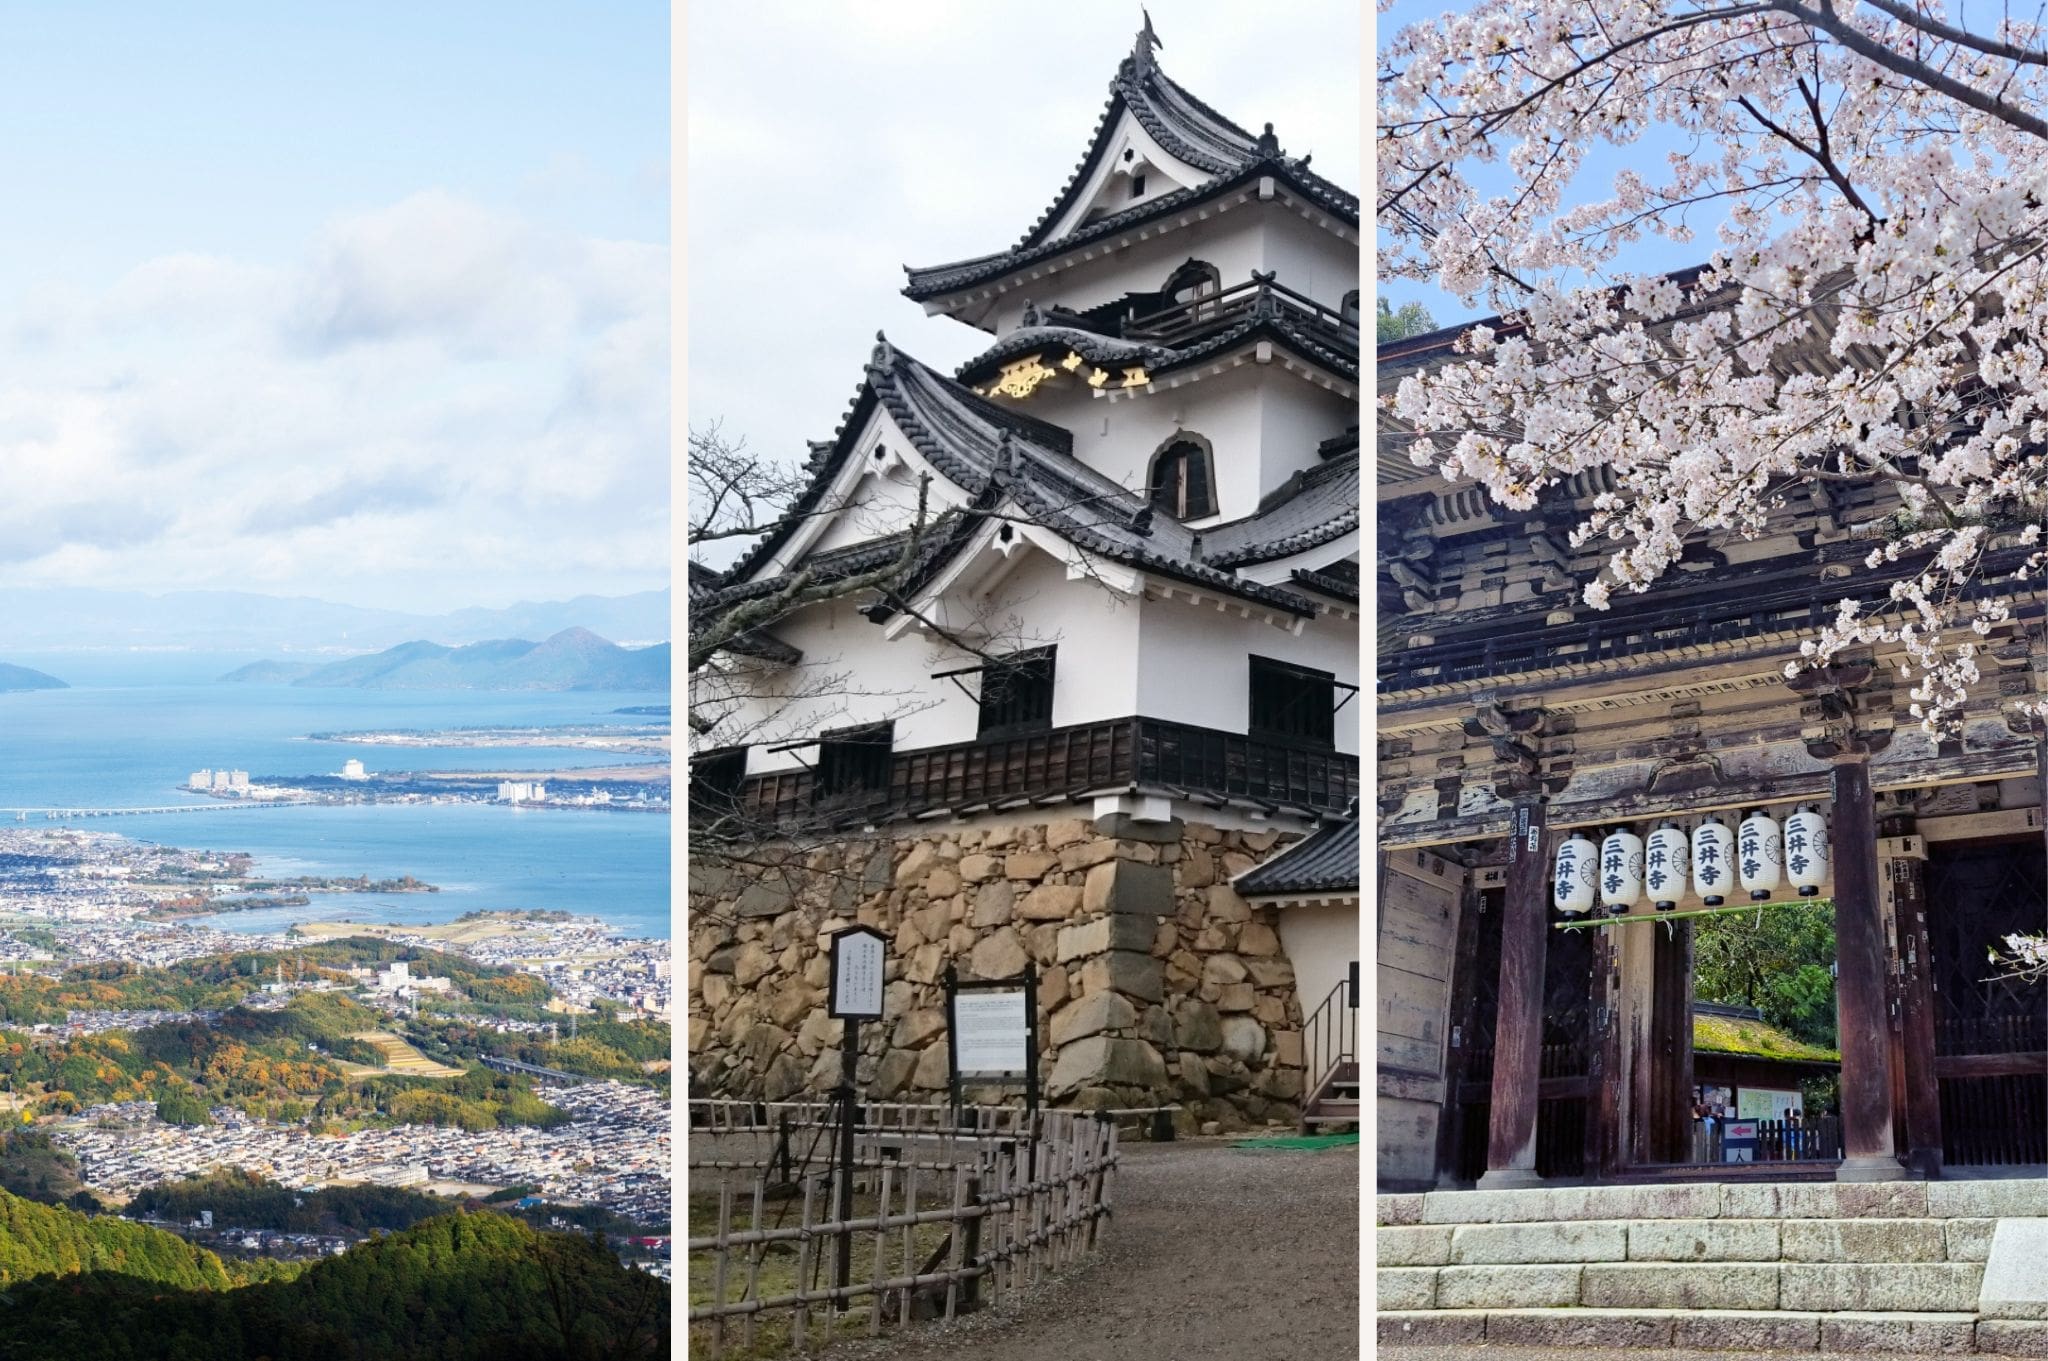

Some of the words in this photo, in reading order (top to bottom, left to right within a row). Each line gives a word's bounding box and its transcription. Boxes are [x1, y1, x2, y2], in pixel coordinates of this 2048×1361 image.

[1556, 844, 1577, 901] 三井寺
[1603, 839, 1625, 895] 三井寺
[1647, 833, 1668, 891] 三井寺
[1697, 829, 1721, 886] 三井寺
[1740, 822, 1762, 880] 三井寺
[1788, 817, 1810, 876] 三井寺
